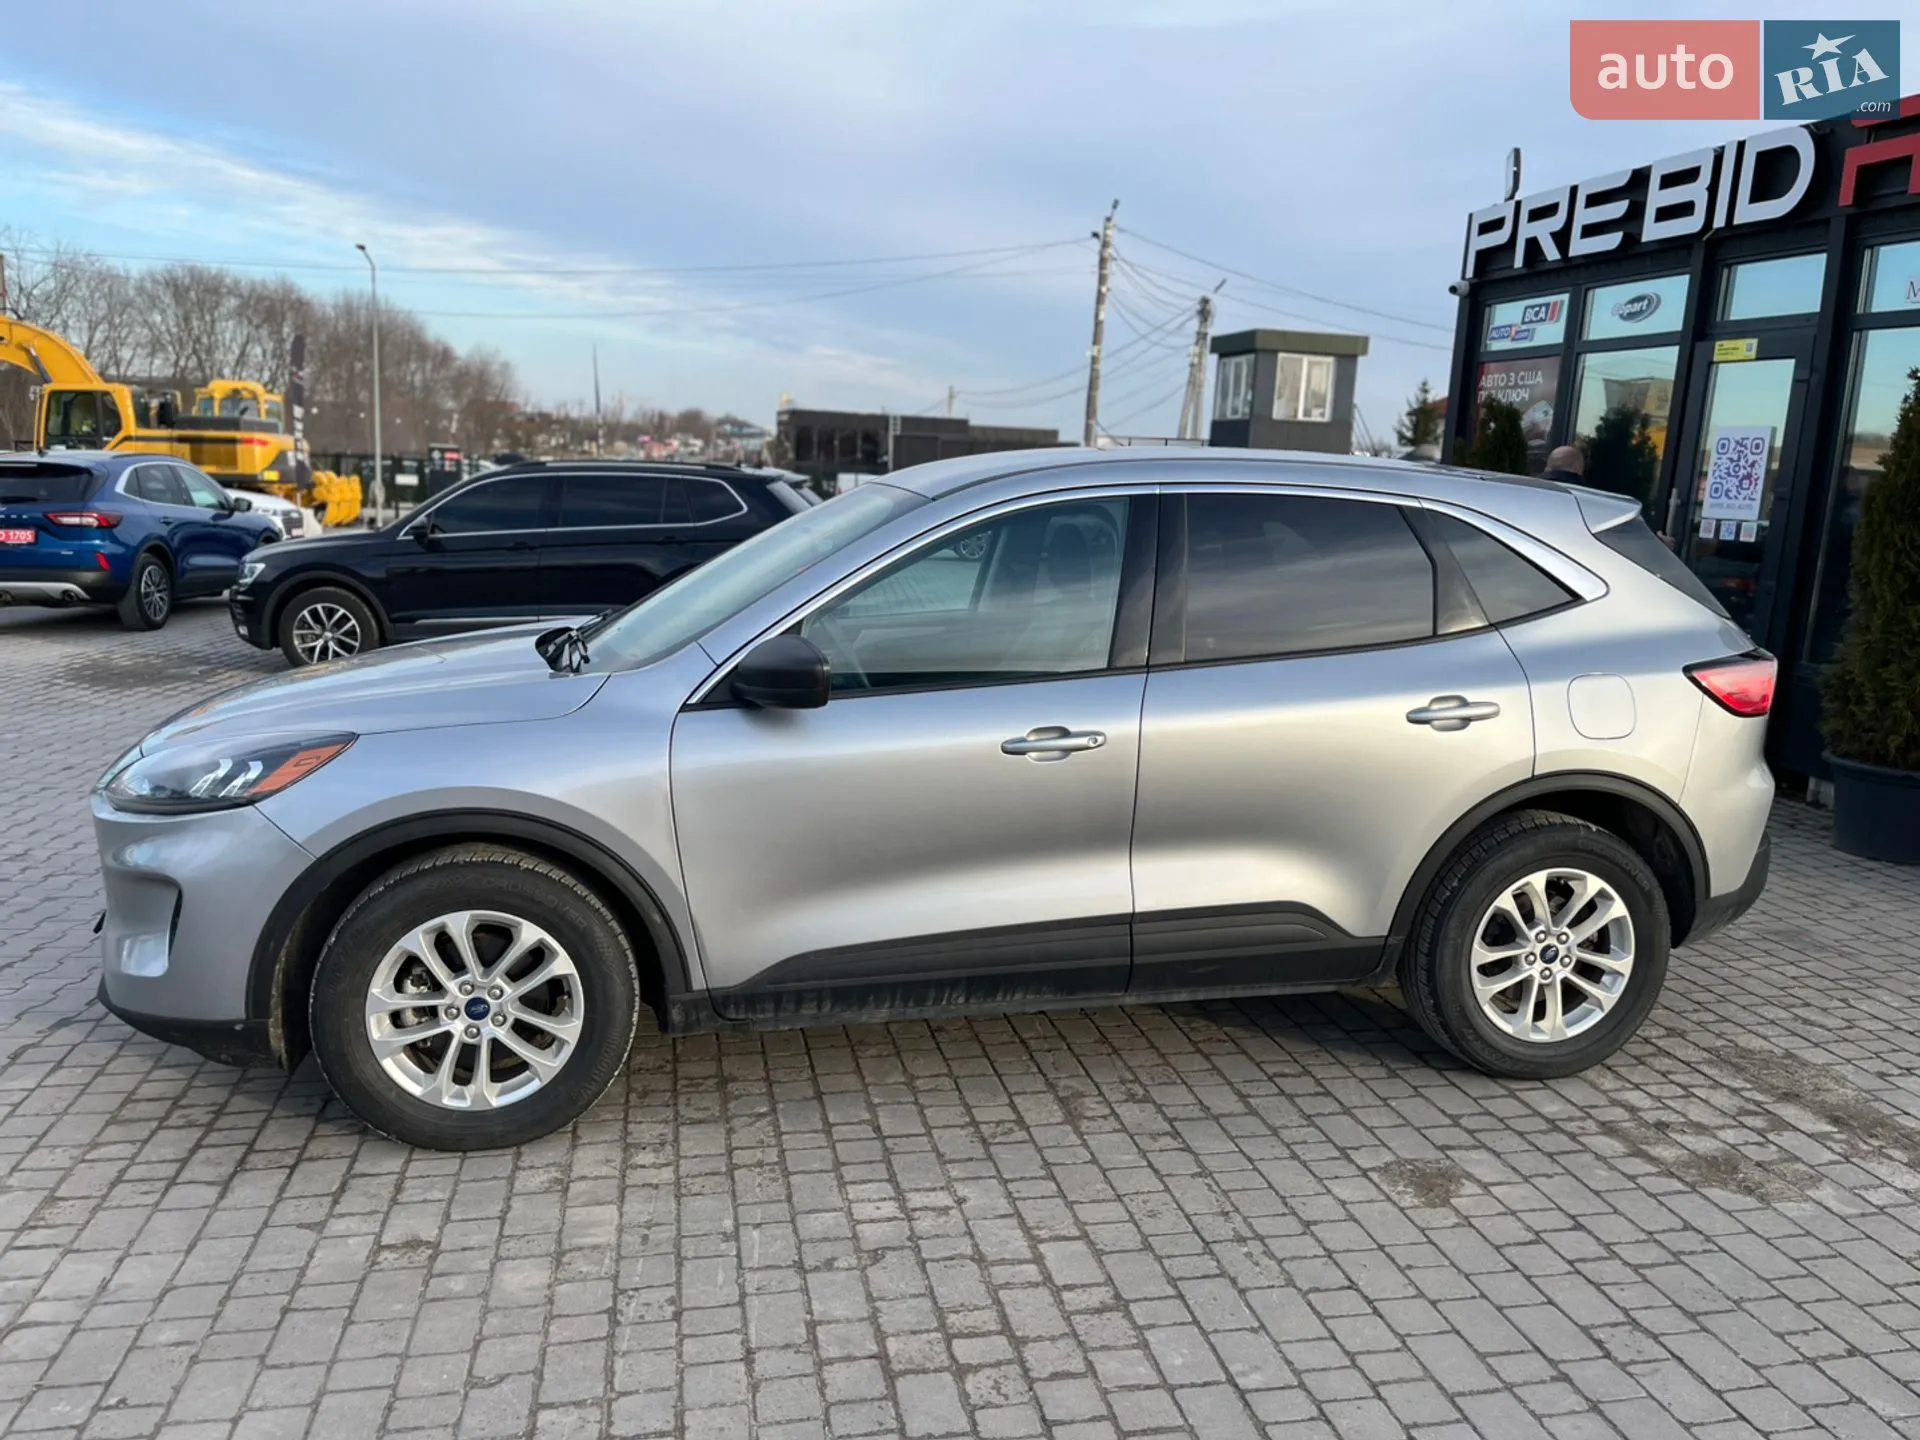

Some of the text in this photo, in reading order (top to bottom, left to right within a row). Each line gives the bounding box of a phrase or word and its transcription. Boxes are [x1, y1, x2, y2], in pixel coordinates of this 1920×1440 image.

[1524, 305, 1547, 321] BCA
[1478, 373, 1507, 388] АВТО
[1517, 370, 1544, 385] США
